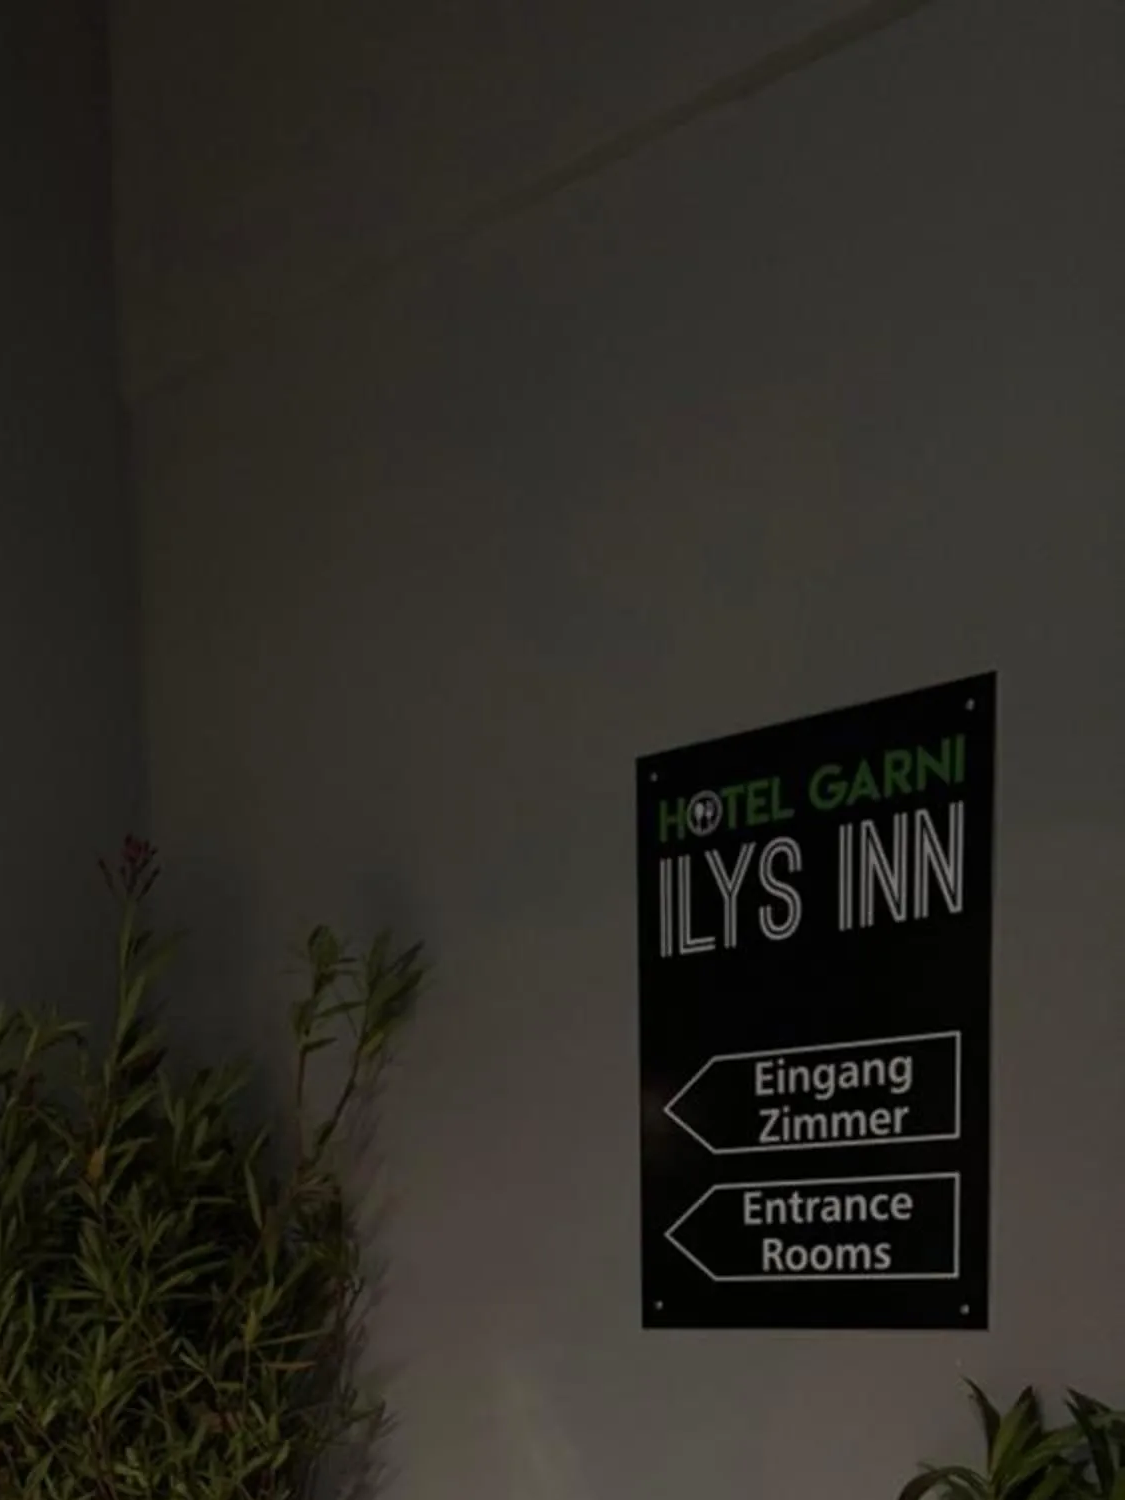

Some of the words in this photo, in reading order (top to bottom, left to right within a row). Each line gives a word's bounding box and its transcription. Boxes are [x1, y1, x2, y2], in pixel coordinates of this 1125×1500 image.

[807, 732, 966, 812] GARNI
[659, 835, 803, 958] ILYS
[837, 800, 964, 932] INN
[753, 1055, 913, 1101] Eingang
[758, 1104, 910, 1144] Zimmer
[742, 1190, 914, 1226] Entrance
[761, 1237, 892, 1272] Rooms
